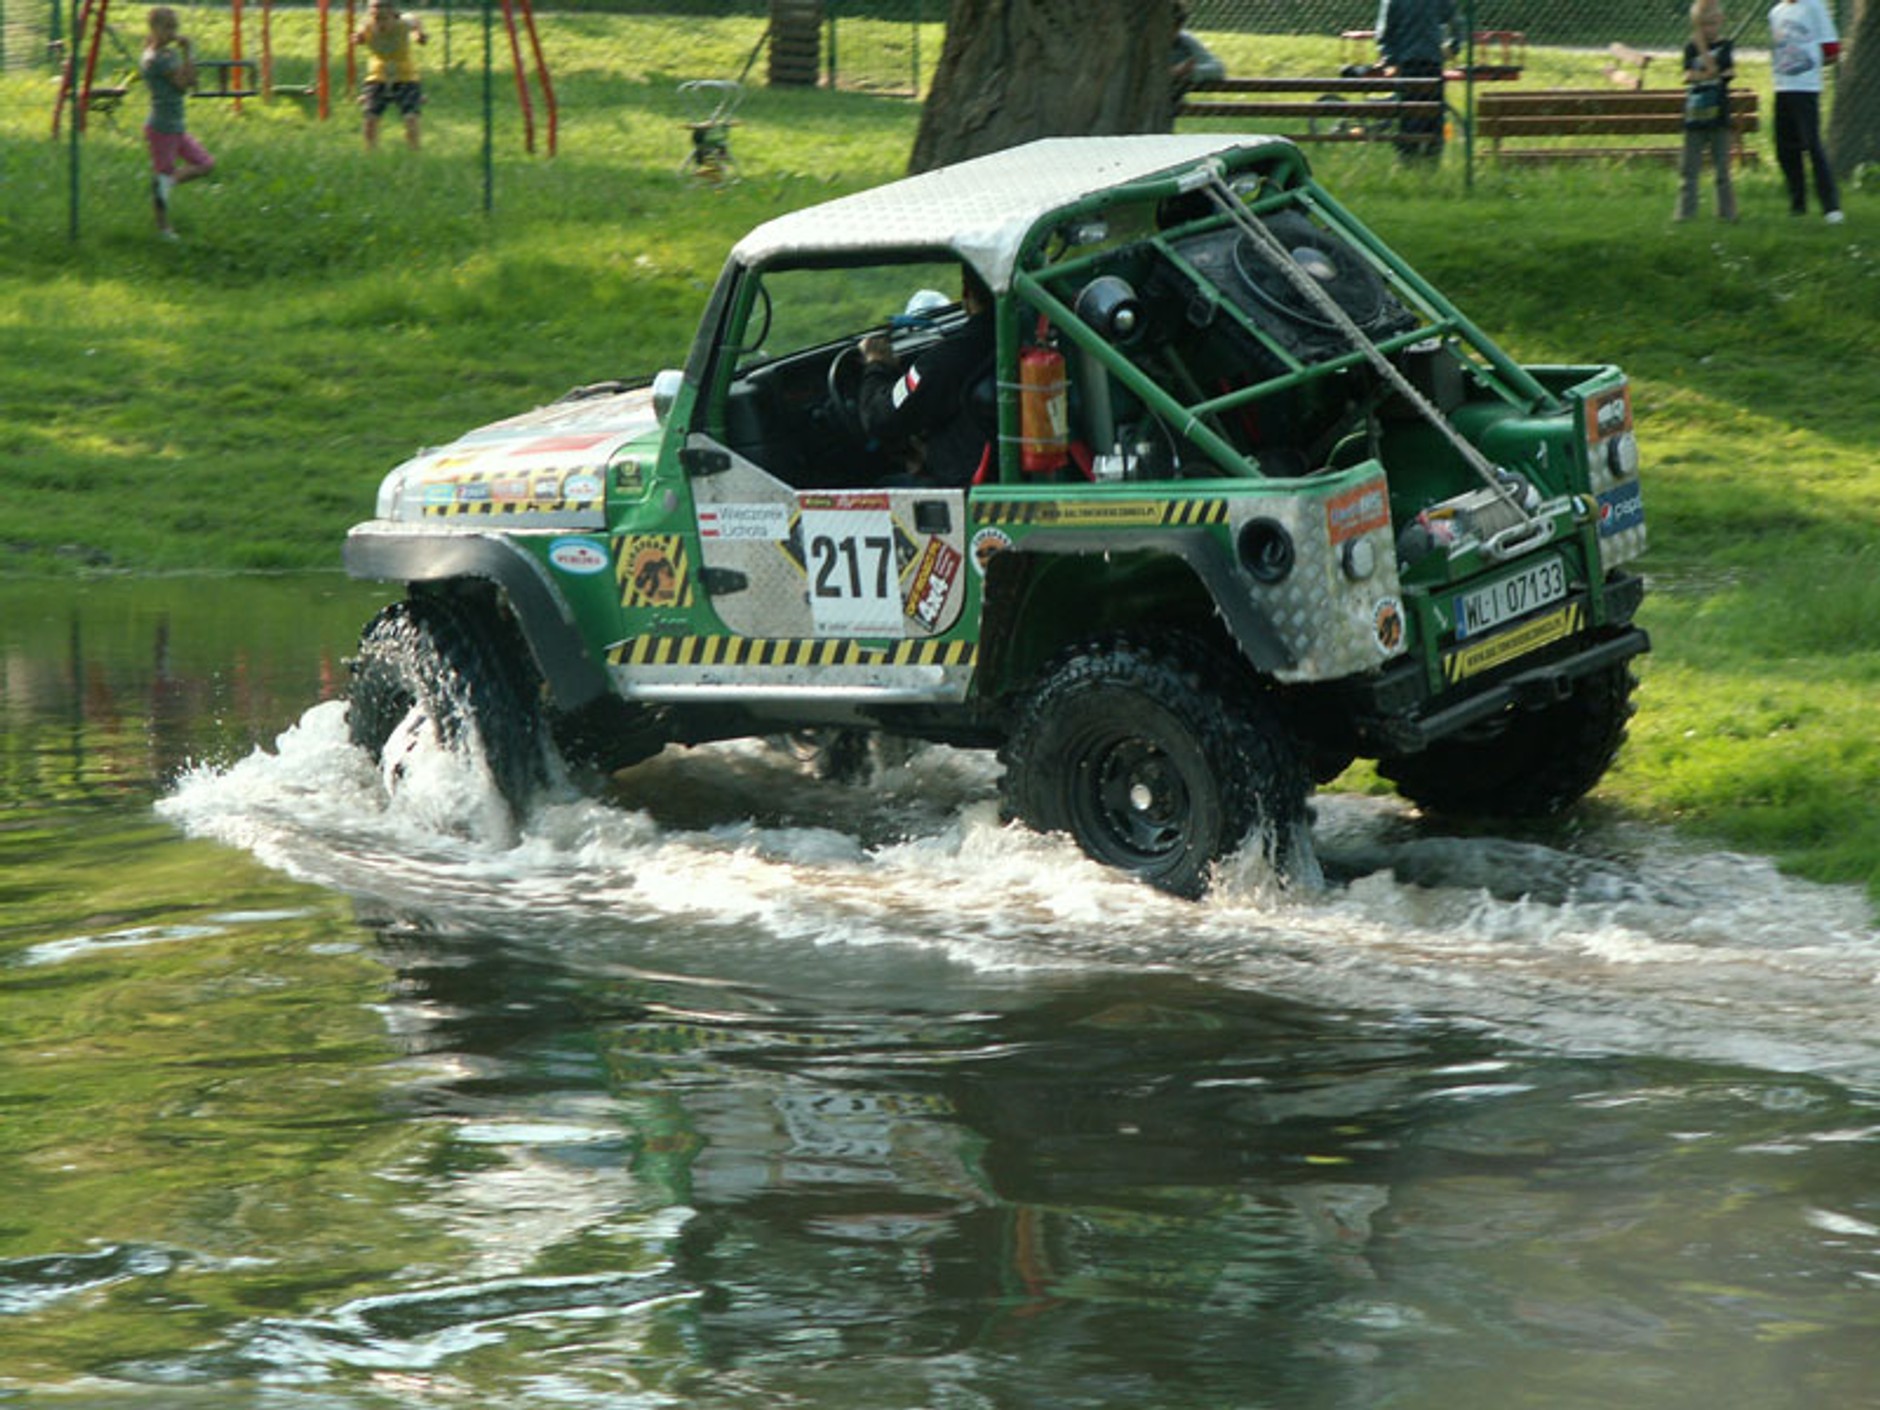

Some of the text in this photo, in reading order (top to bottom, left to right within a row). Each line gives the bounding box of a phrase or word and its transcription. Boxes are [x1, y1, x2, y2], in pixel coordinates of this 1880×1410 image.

[811, 534, 892, 599] 217
[1465, 563, 1563, 631] WLI 07133
